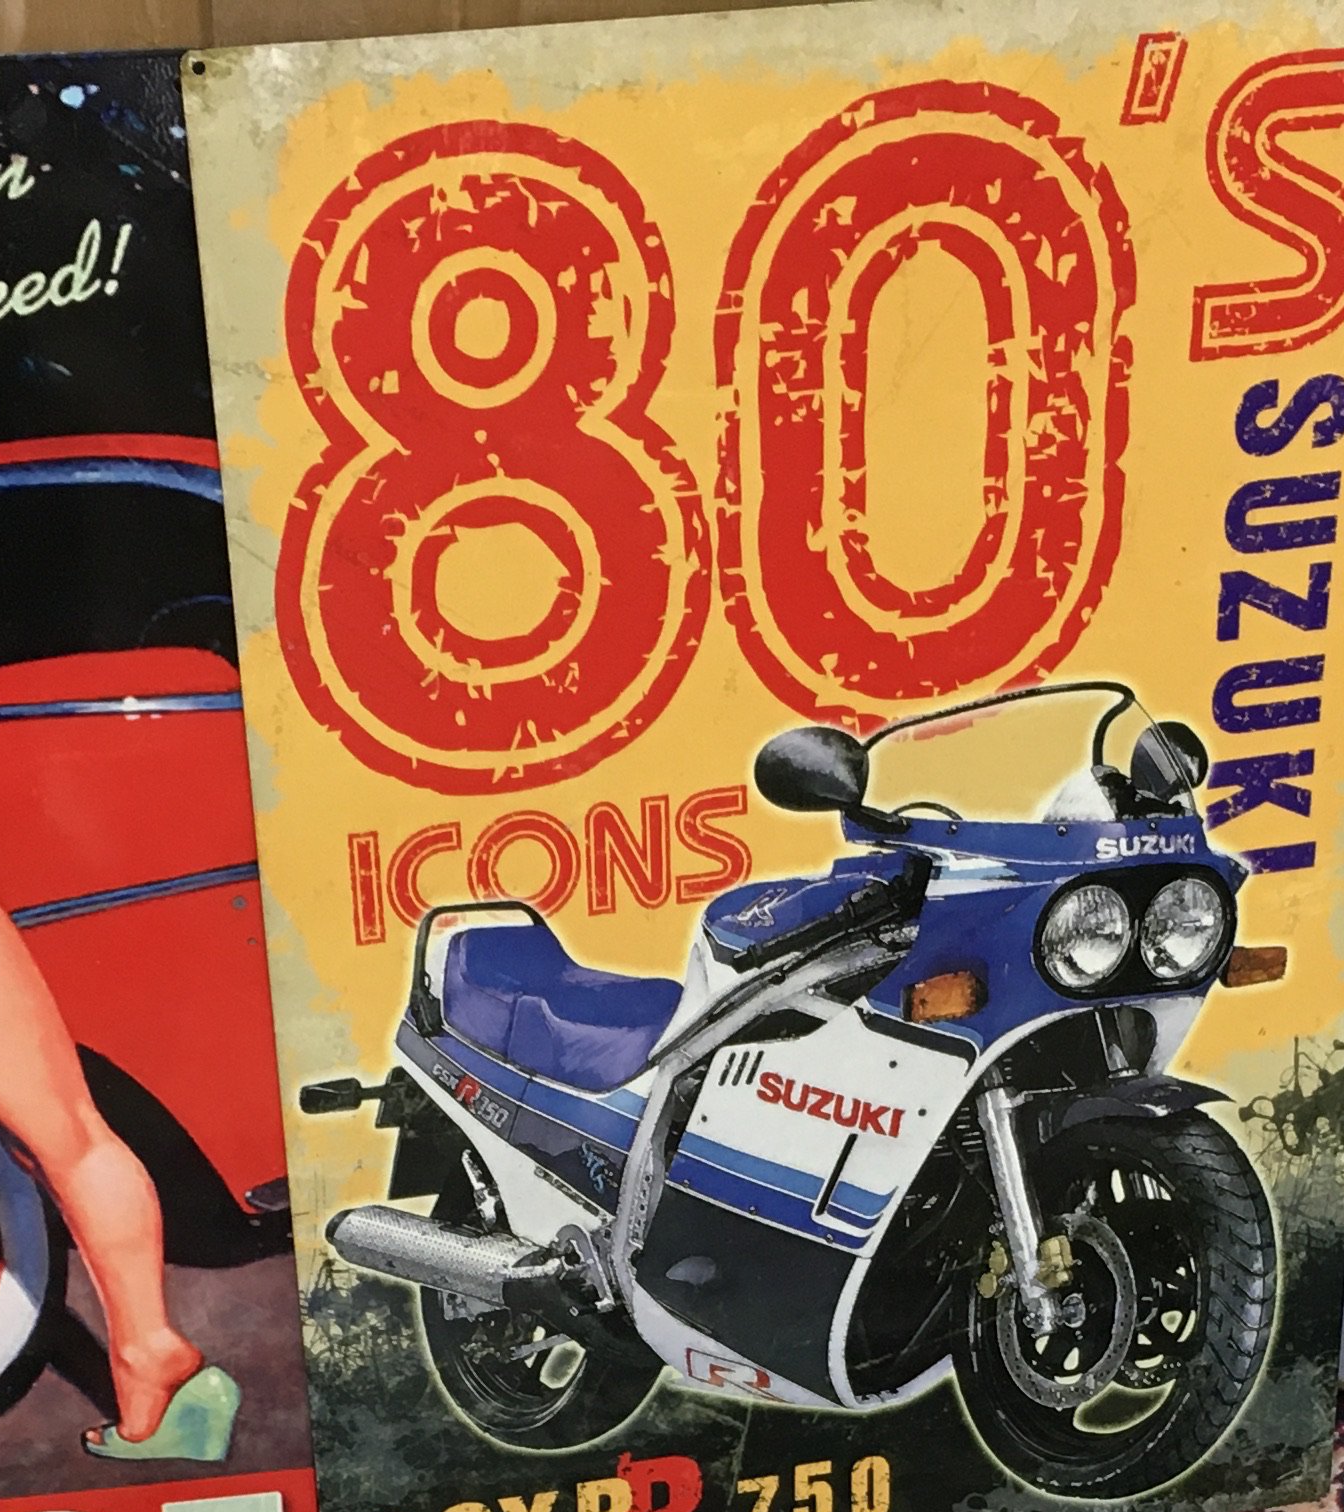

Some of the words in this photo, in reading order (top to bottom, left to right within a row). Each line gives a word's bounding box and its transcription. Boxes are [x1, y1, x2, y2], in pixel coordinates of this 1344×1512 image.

[347, 783, 753, 947] ICONS
[1095, 833, 1196, 860] SUZUKI
[756, 1071, 906, 1139] SUZUKI
